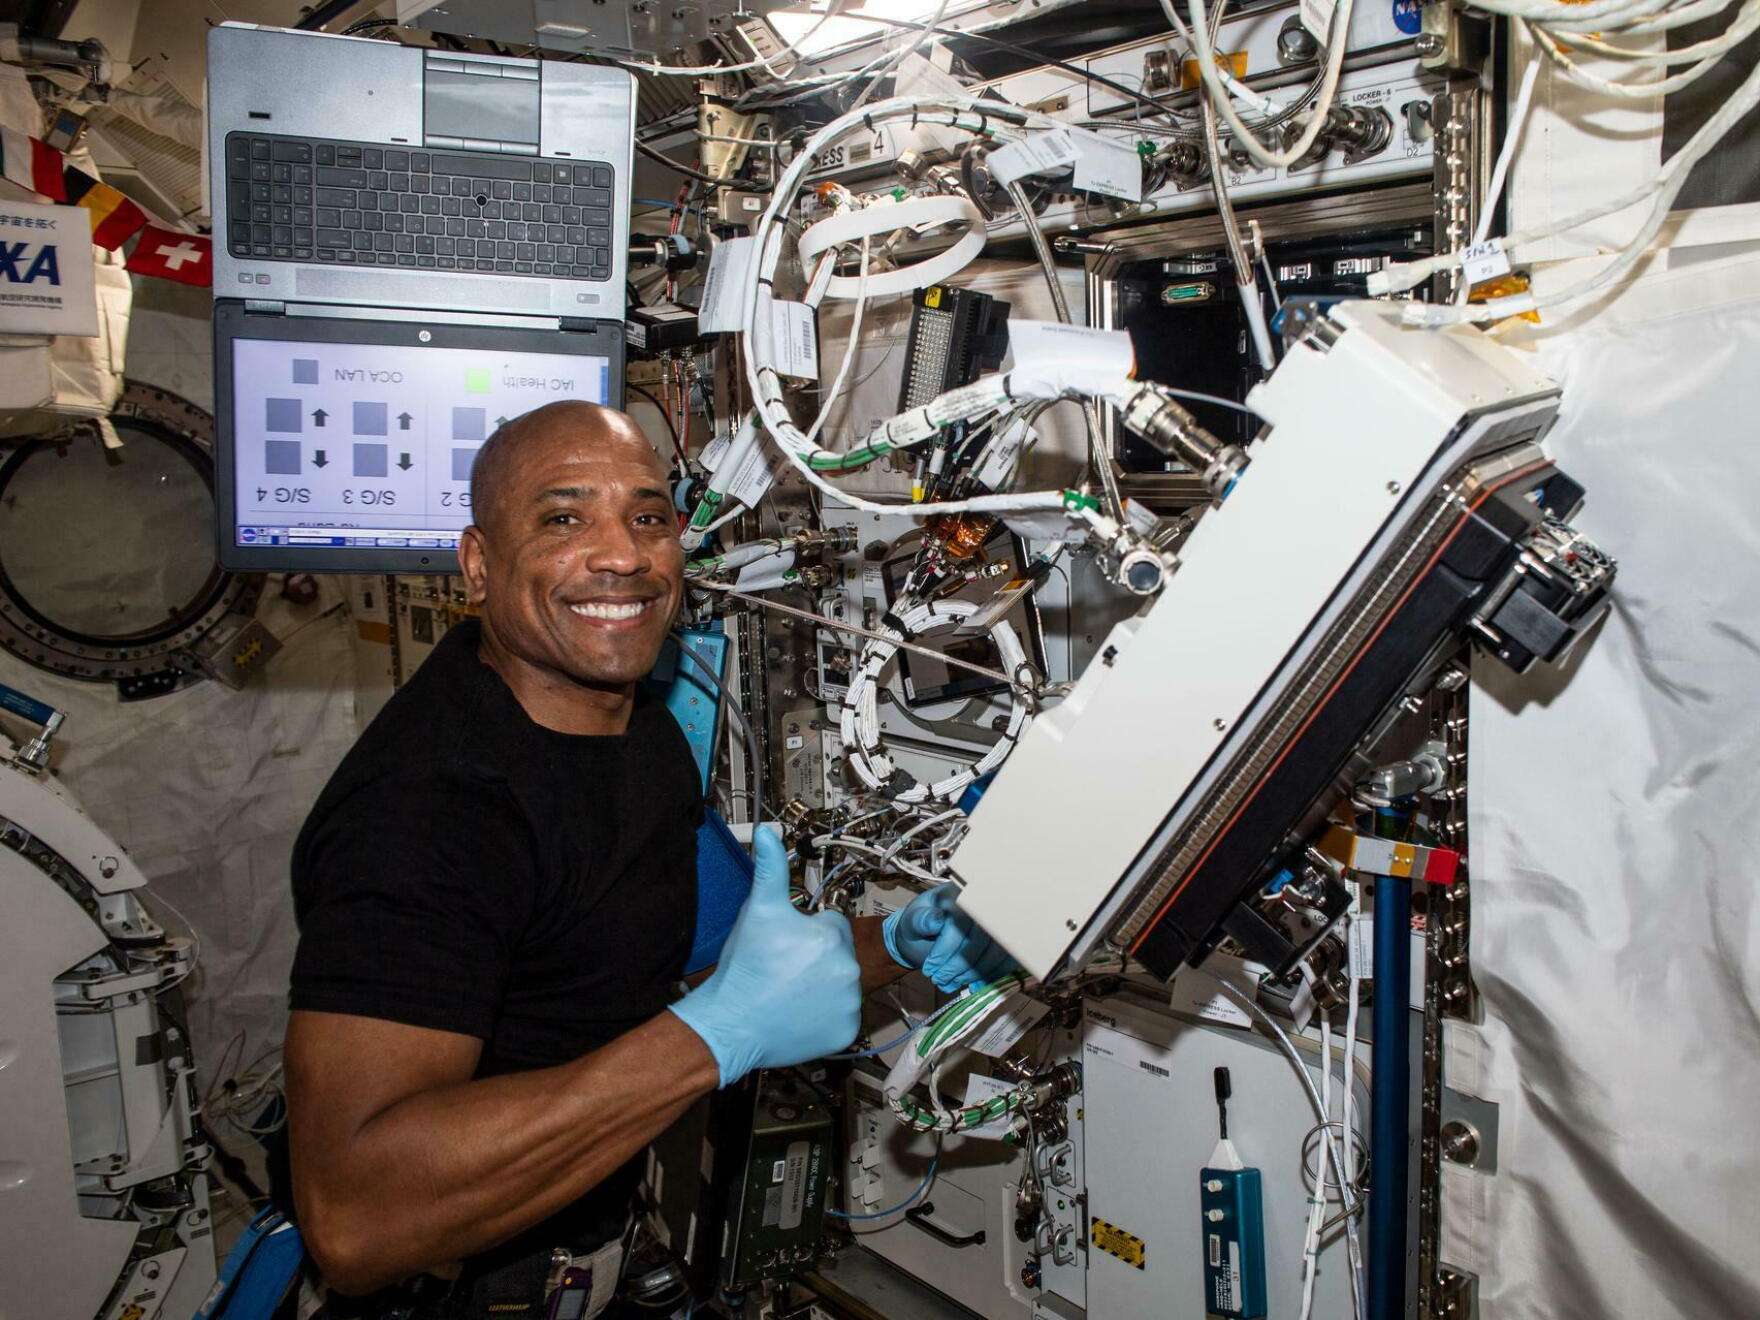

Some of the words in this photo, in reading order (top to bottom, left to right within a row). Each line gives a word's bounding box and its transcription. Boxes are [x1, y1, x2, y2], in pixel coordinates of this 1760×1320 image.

[1353, 90, 1381, 102] LOCKER
[874, 129, 884, 154] 4
[1406, 148, 1419, 158] D2
[335, 368, 365, 382] LAN
[370, 370, 403, 383] OCA
[503, 375, 546, 390] Health
[256, 487, 268, 502] 4
[275, 487, 311, 503] S/G
[342, 489, 354, 504] 3
[361, 490, 396, 505] S/G
[441, 491, 452, 507] 2
[1086, 1007, 1116, 1028] Iceberg
[805, 1191, 816, 1208] Supply
